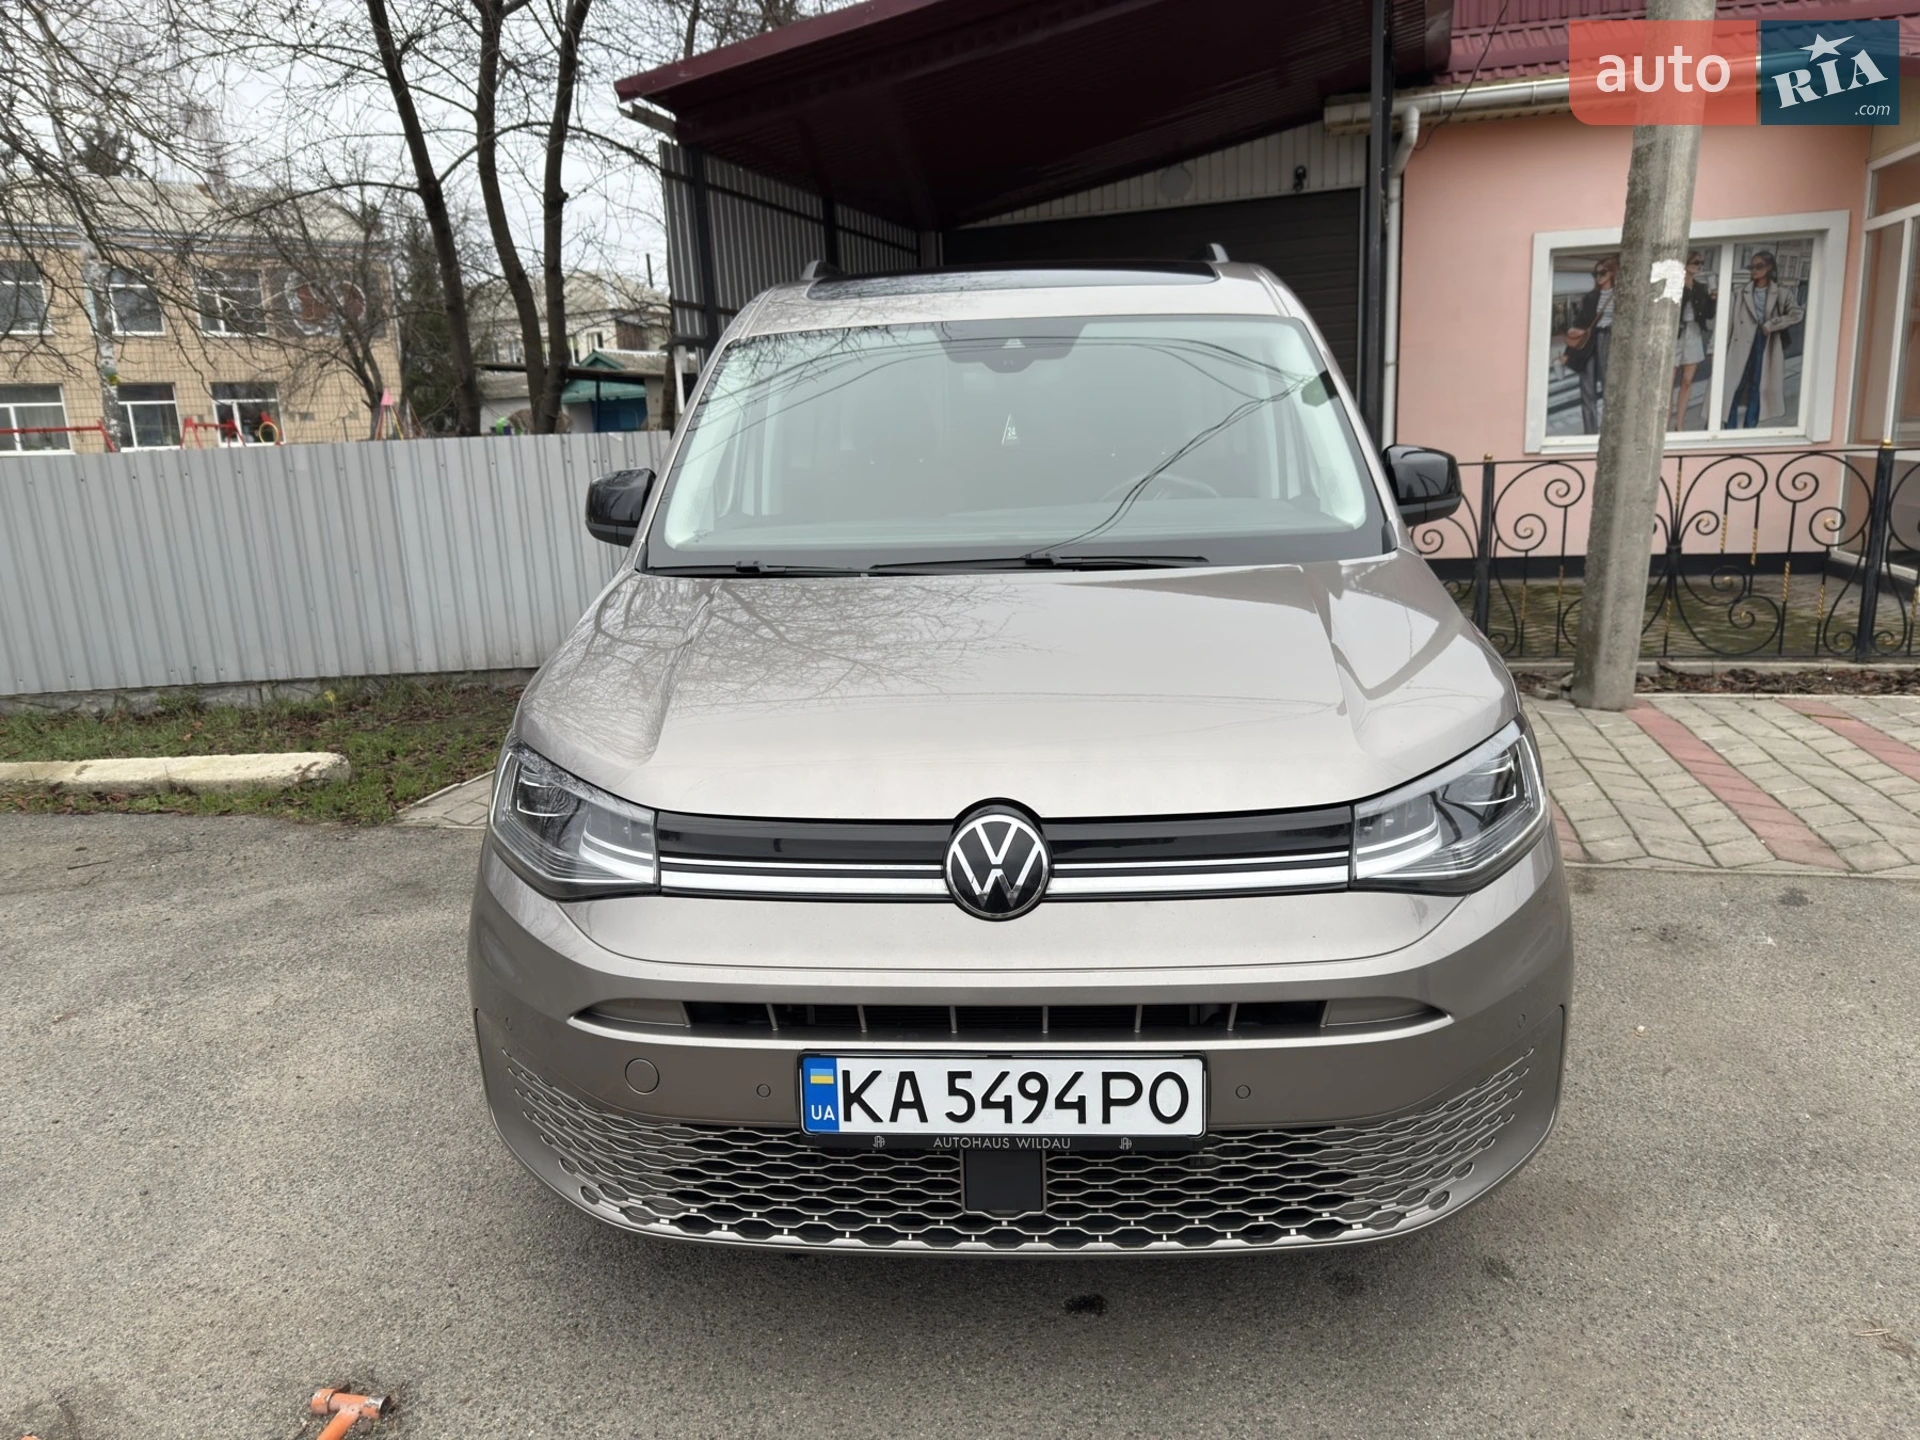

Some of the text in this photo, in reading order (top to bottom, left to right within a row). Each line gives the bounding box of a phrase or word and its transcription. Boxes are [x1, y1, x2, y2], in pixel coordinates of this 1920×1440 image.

[842, 1070, 1189, 1124] KA 5494 PO
[811, 1104, 836, 1121] UA
[933, 1137, 1071, 1149] AUTOHAUS WILDAU
